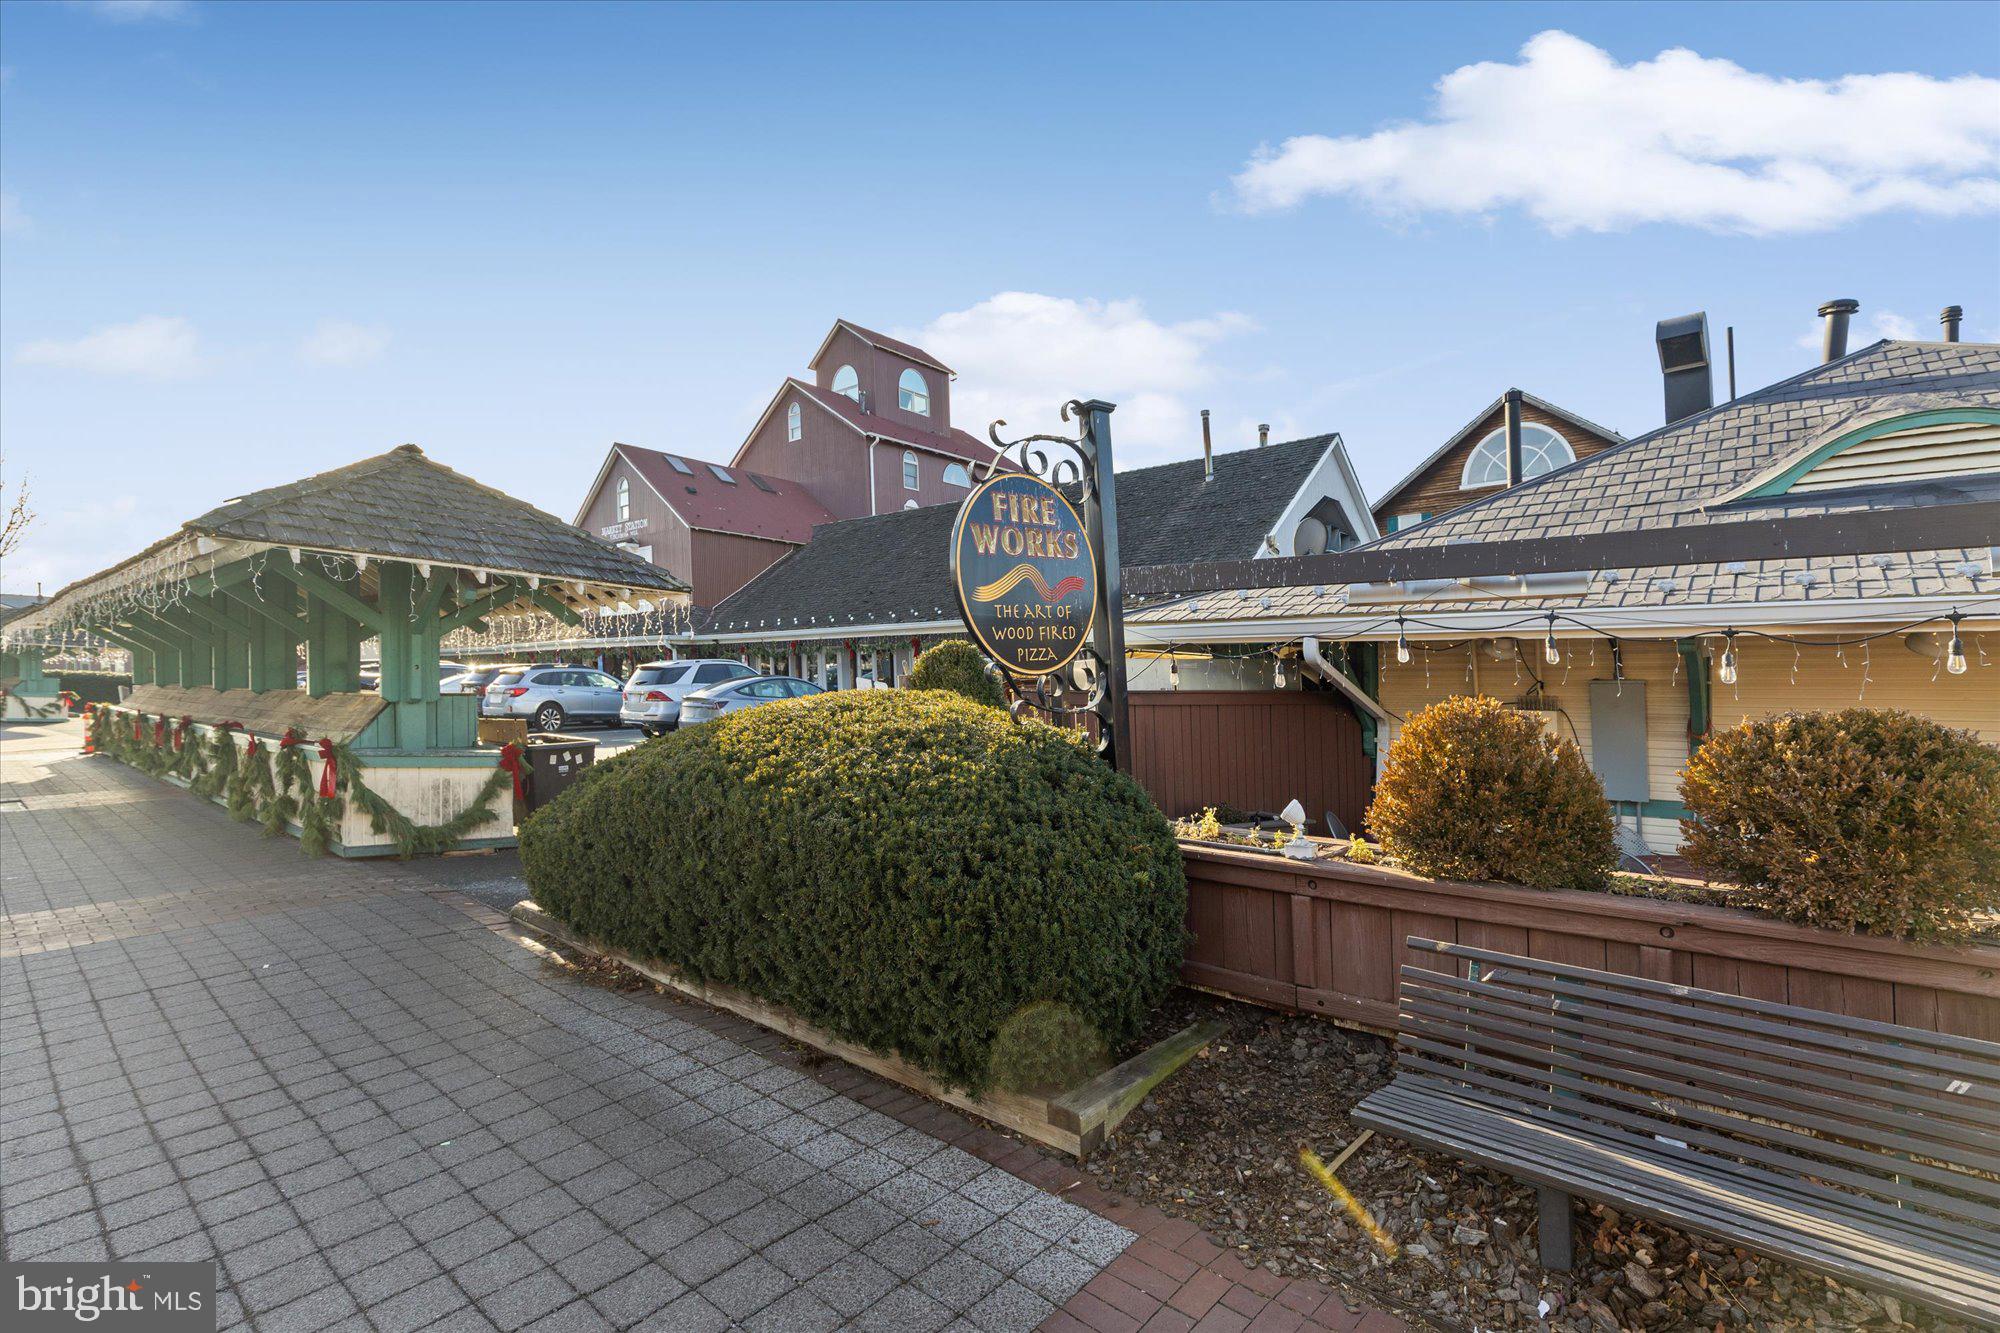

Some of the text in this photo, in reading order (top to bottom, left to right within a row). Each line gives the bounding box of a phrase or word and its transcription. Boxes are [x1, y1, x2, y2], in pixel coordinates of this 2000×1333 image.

[991, 492, 1056, 526] FIRE
[970, 522, 1079, 560] WORKS
[994, 604, 1072, 619] THE ART OF
[992, 626, 1076, 641] WOOD FIRED
[1017, 647, 1058, 662] PIZZA
